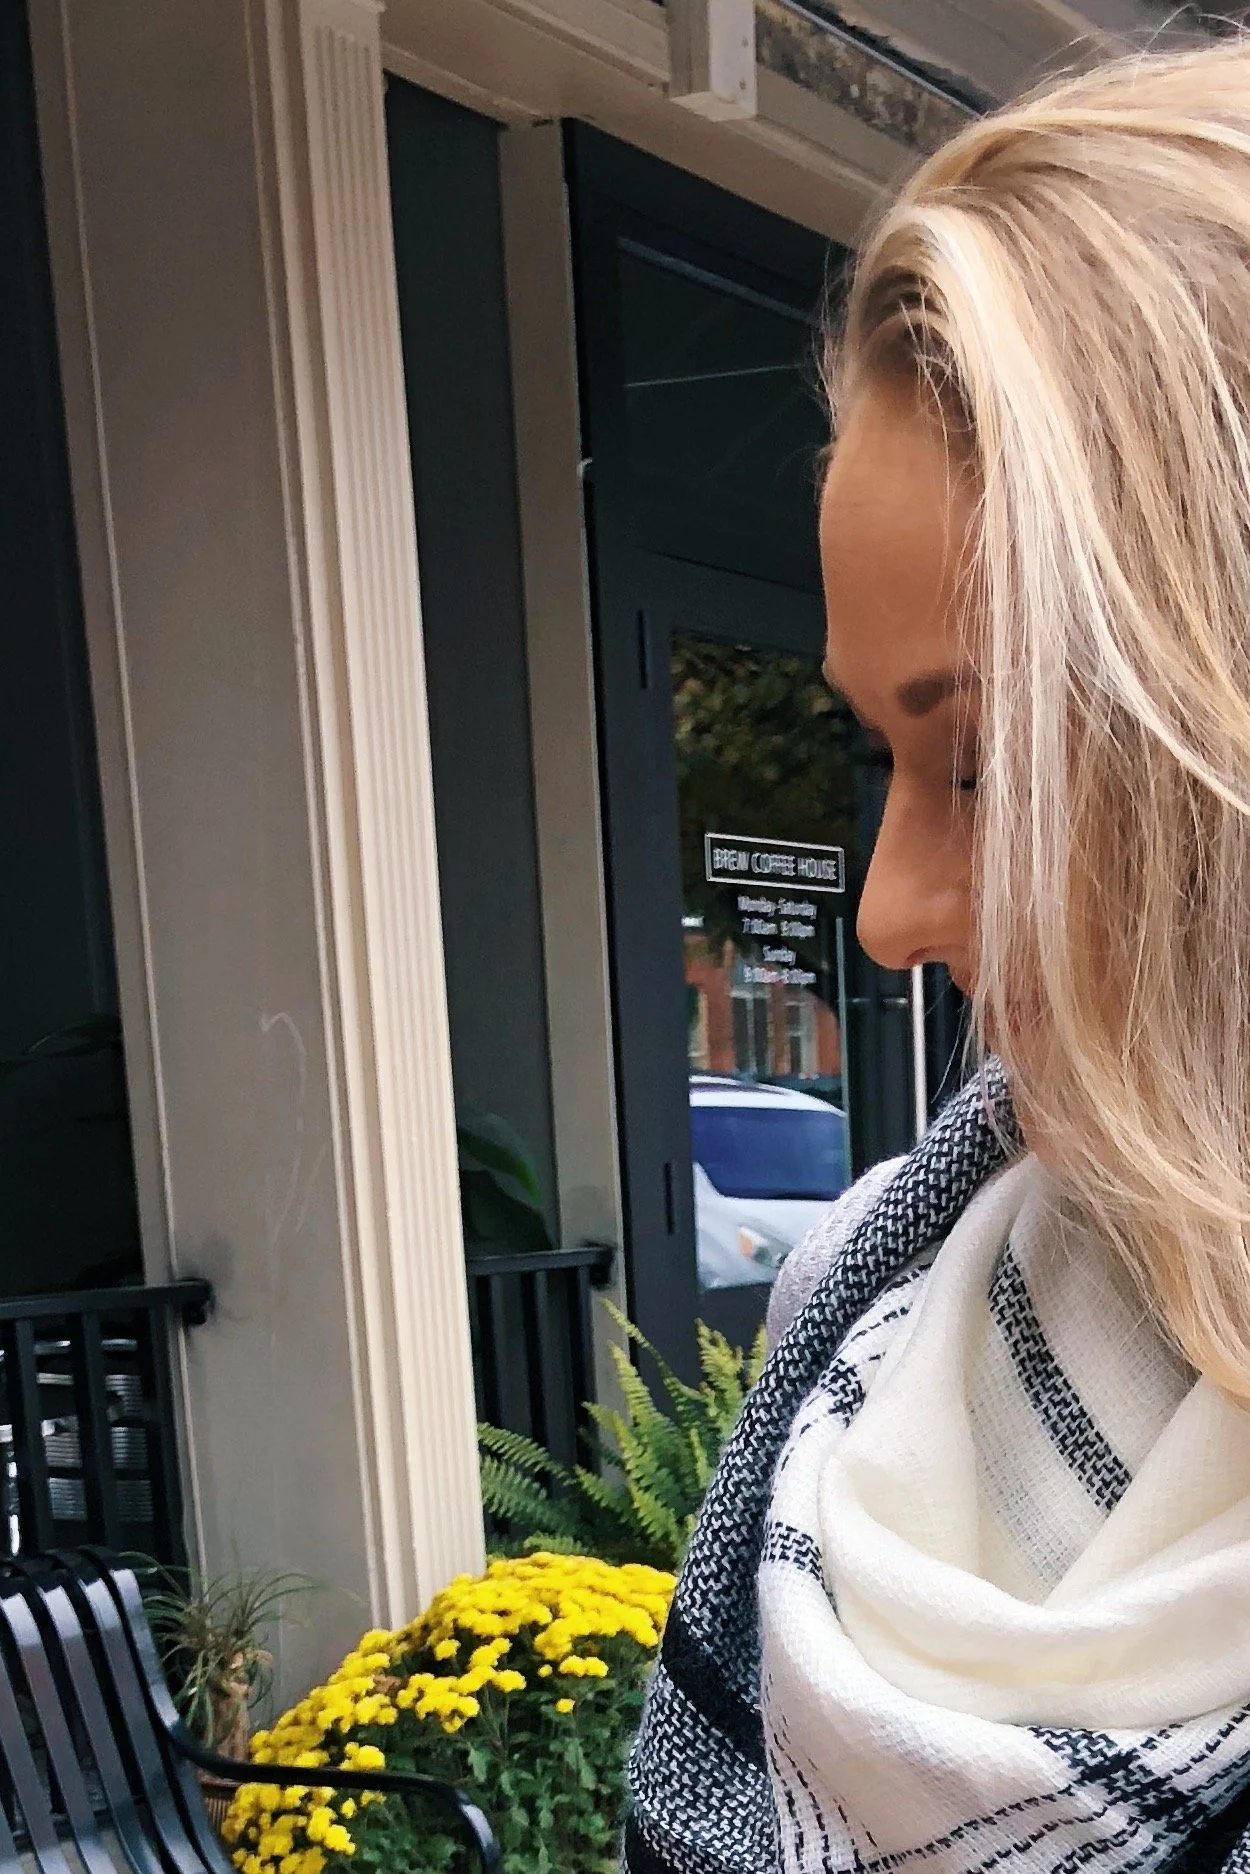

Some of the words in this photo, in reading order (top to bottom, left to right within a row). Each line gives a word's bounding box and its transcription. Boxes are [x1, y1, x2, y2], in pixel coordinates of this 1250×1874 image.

[713, 848, 749, 871] BREW
[751, 852, 796, 876] COFFEE
[797, 857, 837, 880] HOUSE
